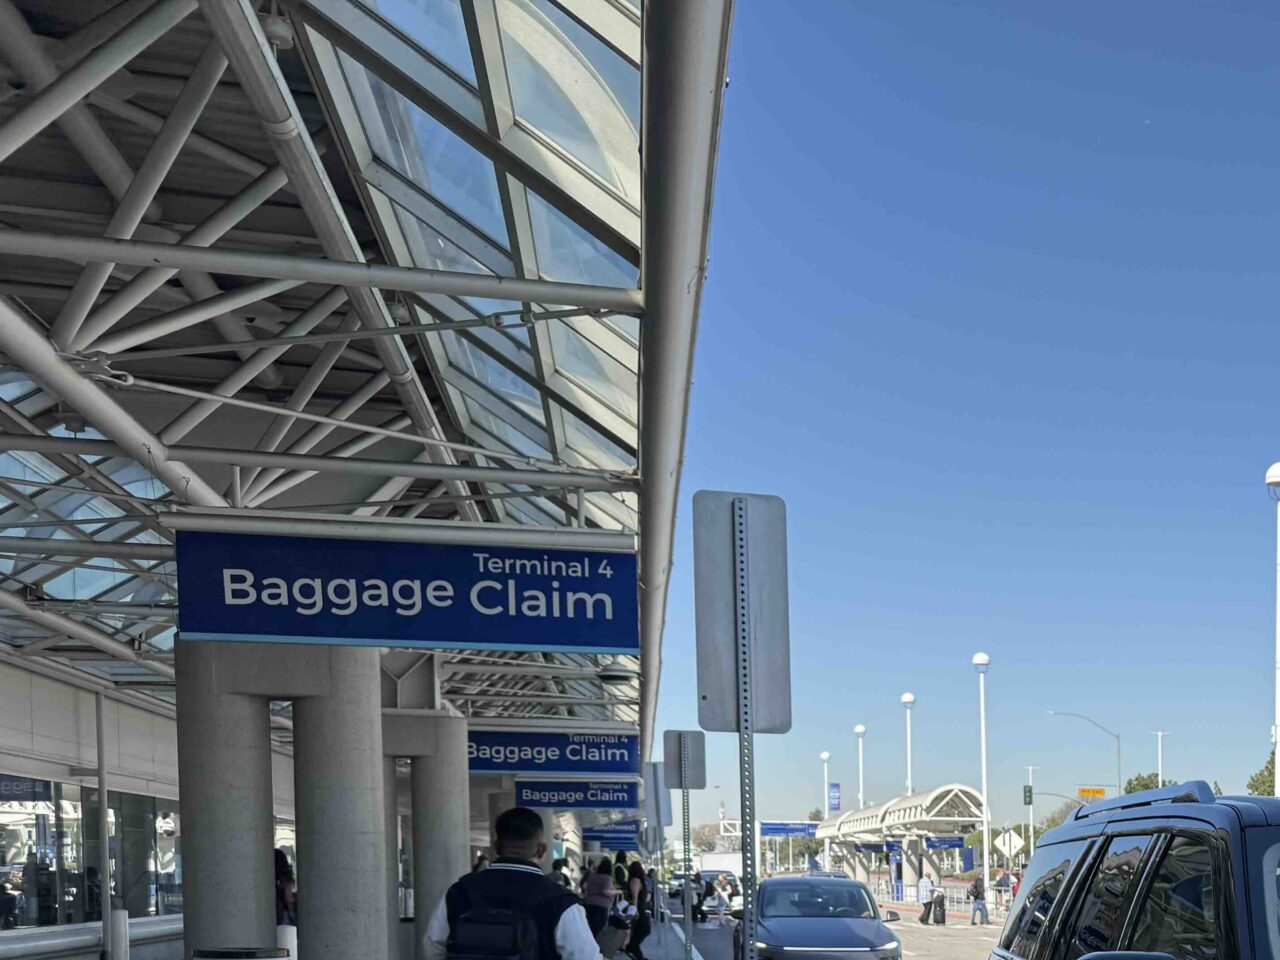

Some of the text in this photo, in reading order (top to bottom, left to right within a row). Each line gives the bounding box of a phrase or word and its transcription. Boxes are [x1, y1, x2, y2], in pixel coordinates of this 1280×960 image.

[473, 553, 614, 579] Terminal 4
[222, 567, 614, 620] Baggage Claim
[568, 733, 629, 744] Terminal 4
[467, 741, 629, 763] Baggage Claim
[588, 782, 621, 790] Terminal
[521, 788, 628, 803] Baggage Claim
